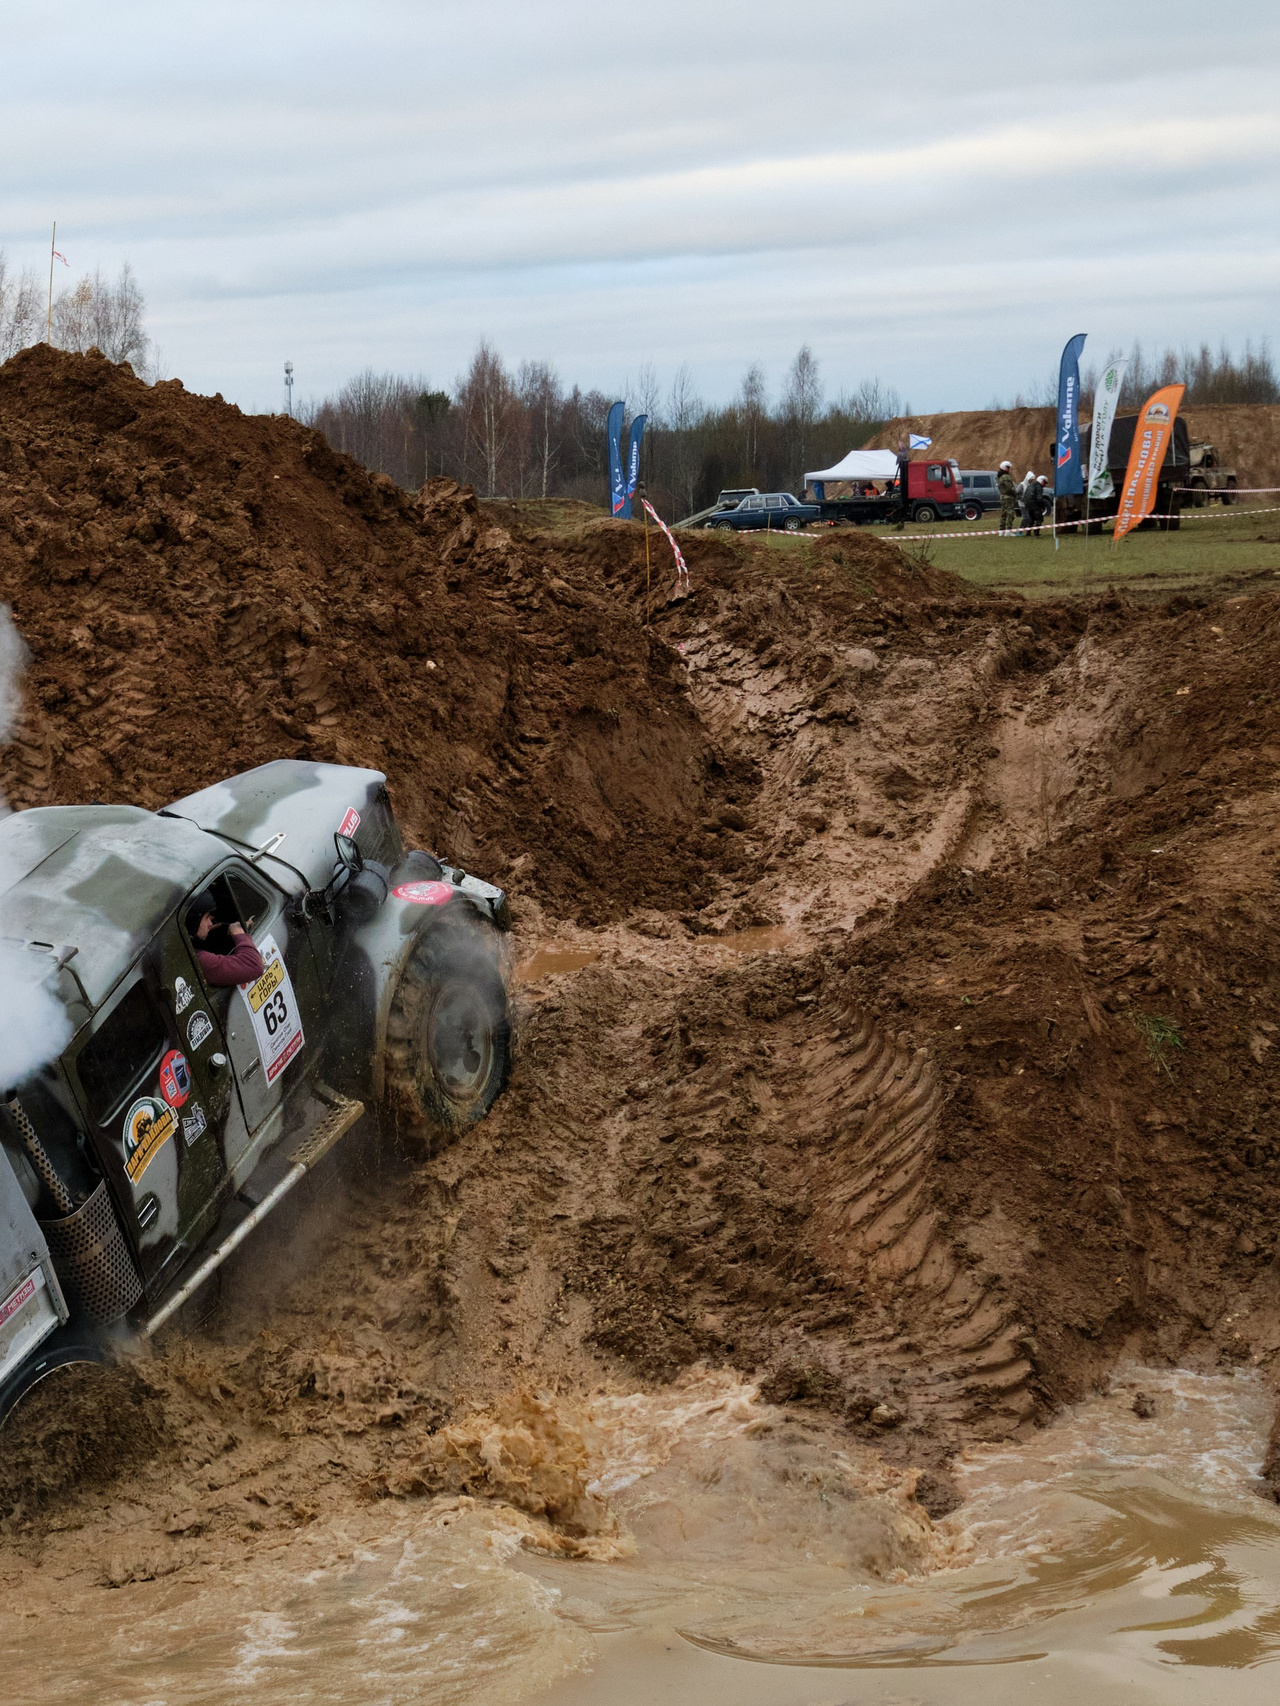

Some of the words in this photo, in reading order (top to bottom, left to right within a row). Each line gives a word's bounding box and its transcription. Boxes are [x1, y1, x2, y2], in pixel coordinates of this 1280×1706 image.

[1062, 376, 1074, 443] Volume
[629, 441, 638, 485] Volume
[257, 971, 274, 992] ЦАРЬ
[259, 976, 278, 1002] ГОРЫ
[263, 990, 288, 1036] 63
